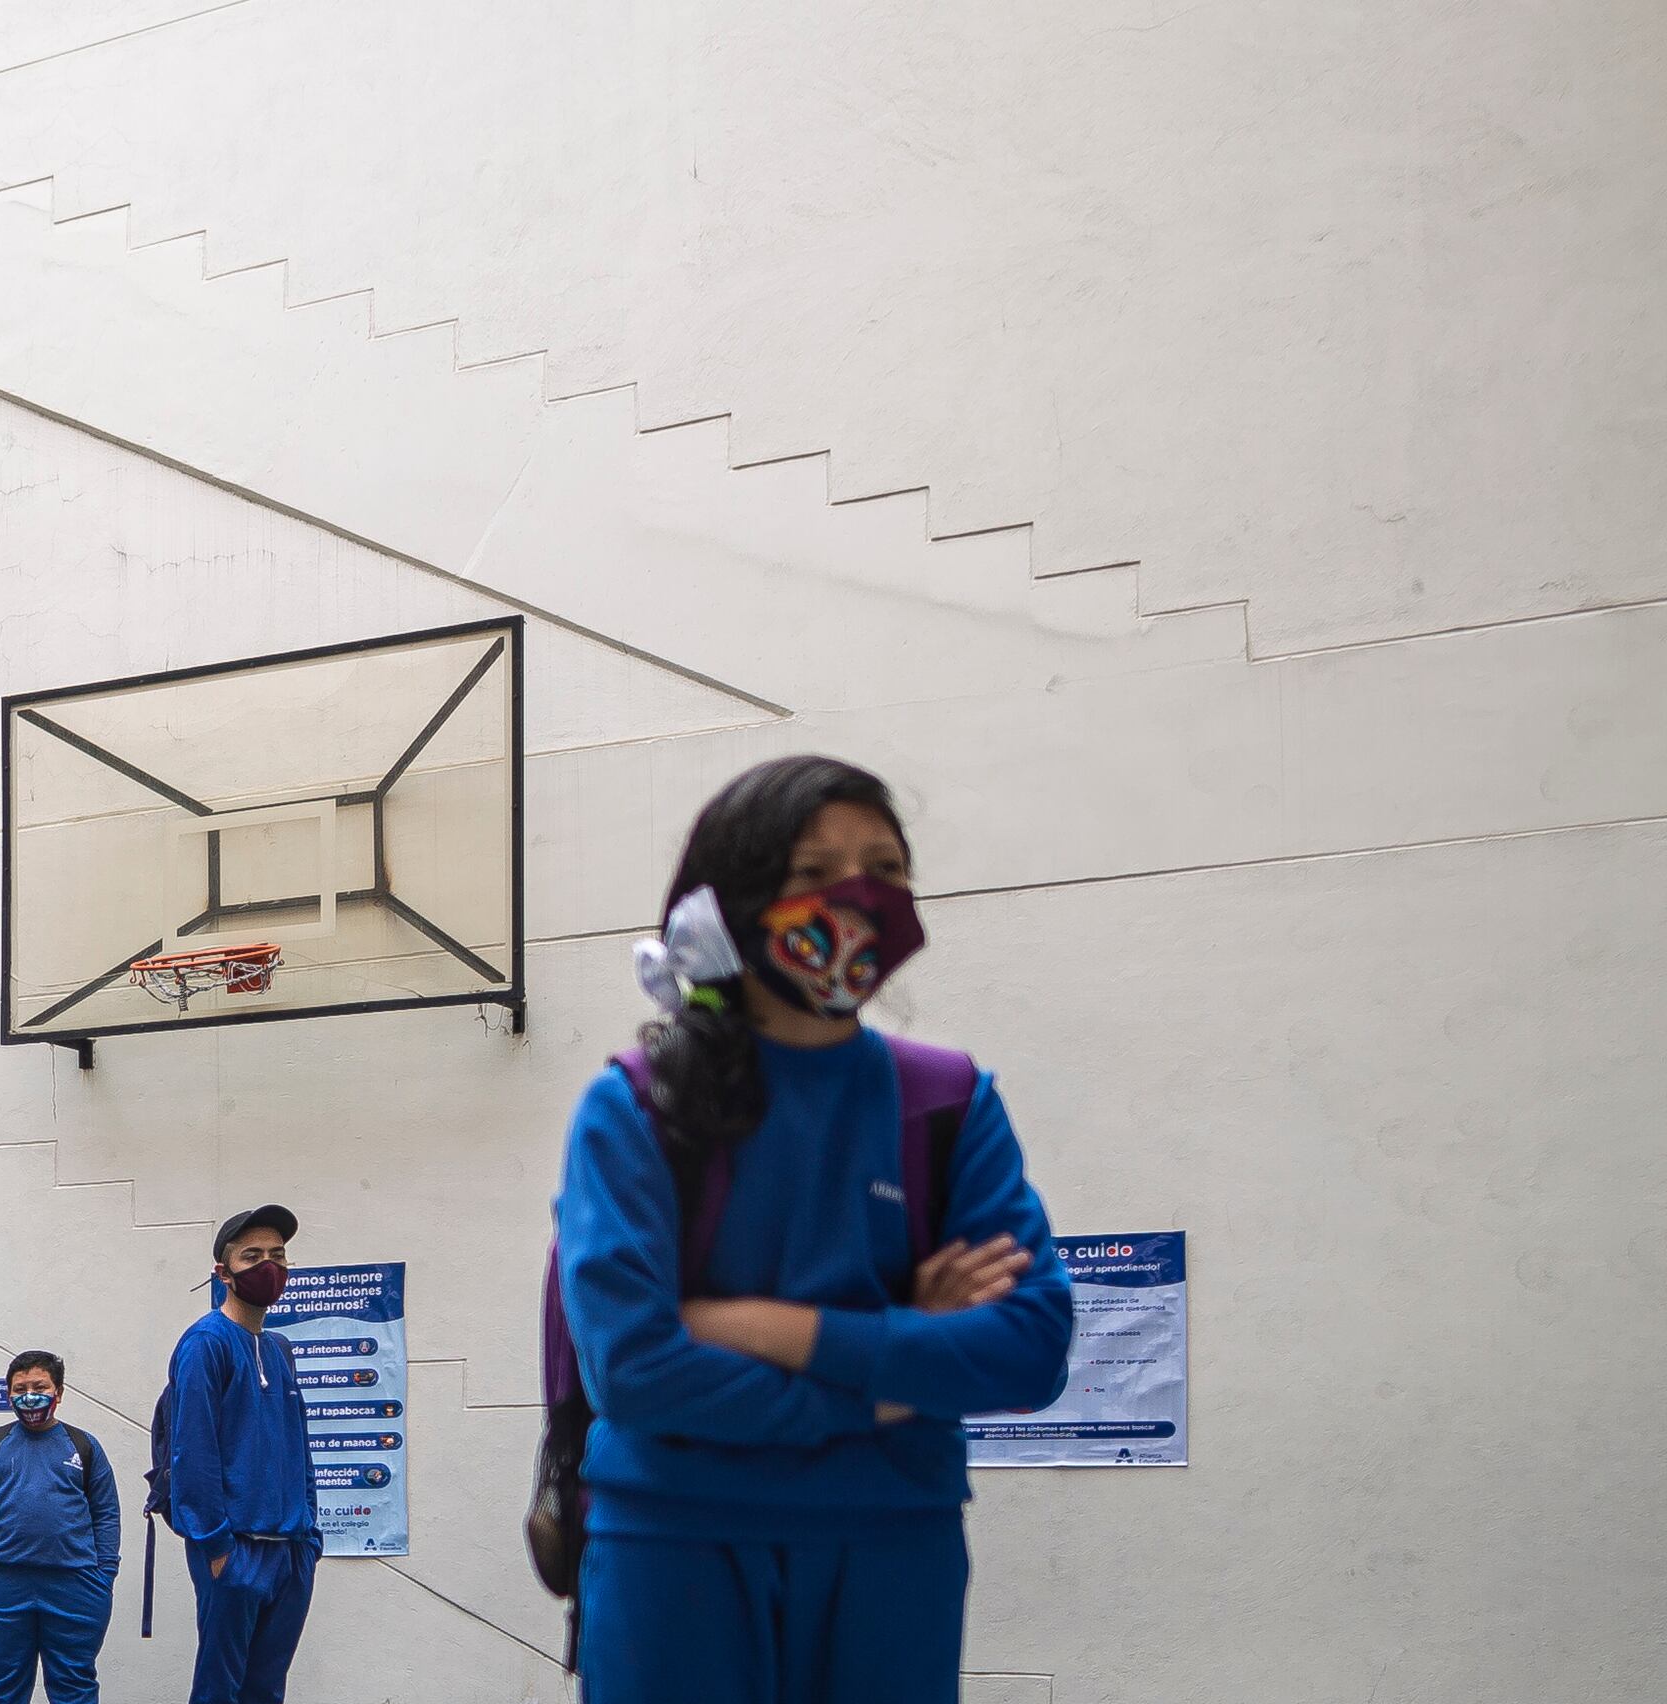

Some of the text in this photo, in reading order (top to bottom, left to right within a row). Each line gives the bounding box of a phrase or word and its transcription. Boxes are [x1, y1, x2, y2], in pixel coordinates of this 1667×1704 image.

[1075, 1241, 1133, 1259] cuido
[1095, 1263, 1161, 1273] aprendiendo!
[328, 1272, 383, 1284] siempre
[294, 1298, 364, 1313] cuidarnos!
[292, 1343, 353, 1355] de síntomas
[321, 1374, 349, 1385] físico
[322, 1406, 375, 1418] tapabocas
[328, 1438, 340, 1447] de
[343, 1438, 377, 1447] manos
[319, 1504, 372, 1516] te cuido
[340, 1520, 369, 1528] colegio
